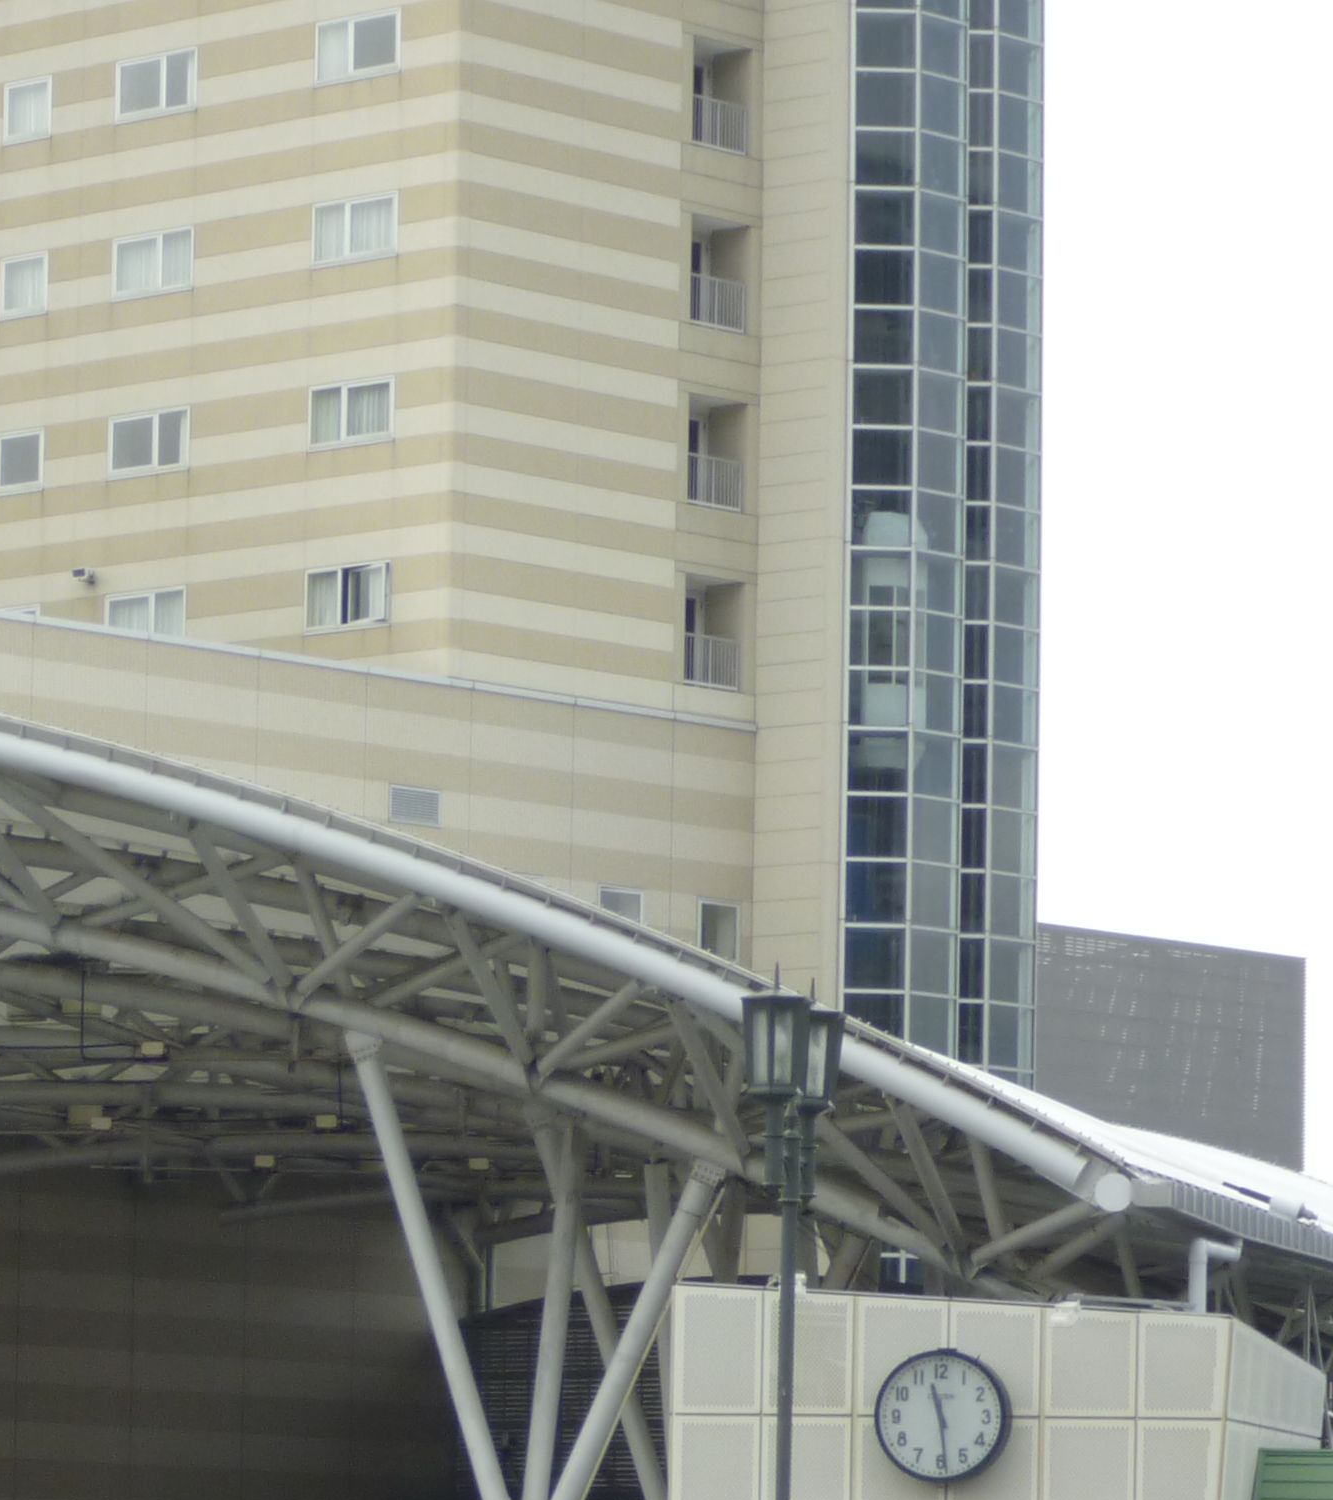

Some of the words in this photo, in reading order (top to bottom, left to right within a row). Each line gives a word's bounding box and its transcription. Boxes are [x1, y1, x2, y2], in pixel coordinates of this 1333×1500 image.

[914, 1370, 925, 1386] 11
[934, 1364, 949, 1380] 12
[896, 1386, 909, 1402] 10
[975, 1387, 985, 1402] 2
[891, 1409, 902, 1424] 9
[981, 1410, 991, 1425] 3
[896, 1431, 907, 1447] 8
[974, 1432, 985, 1446] 4
[913, 1448, 923, 1464] 7
[935, 1454, 947, 1470] 6
[958, 1448, 968, 1464] 5
